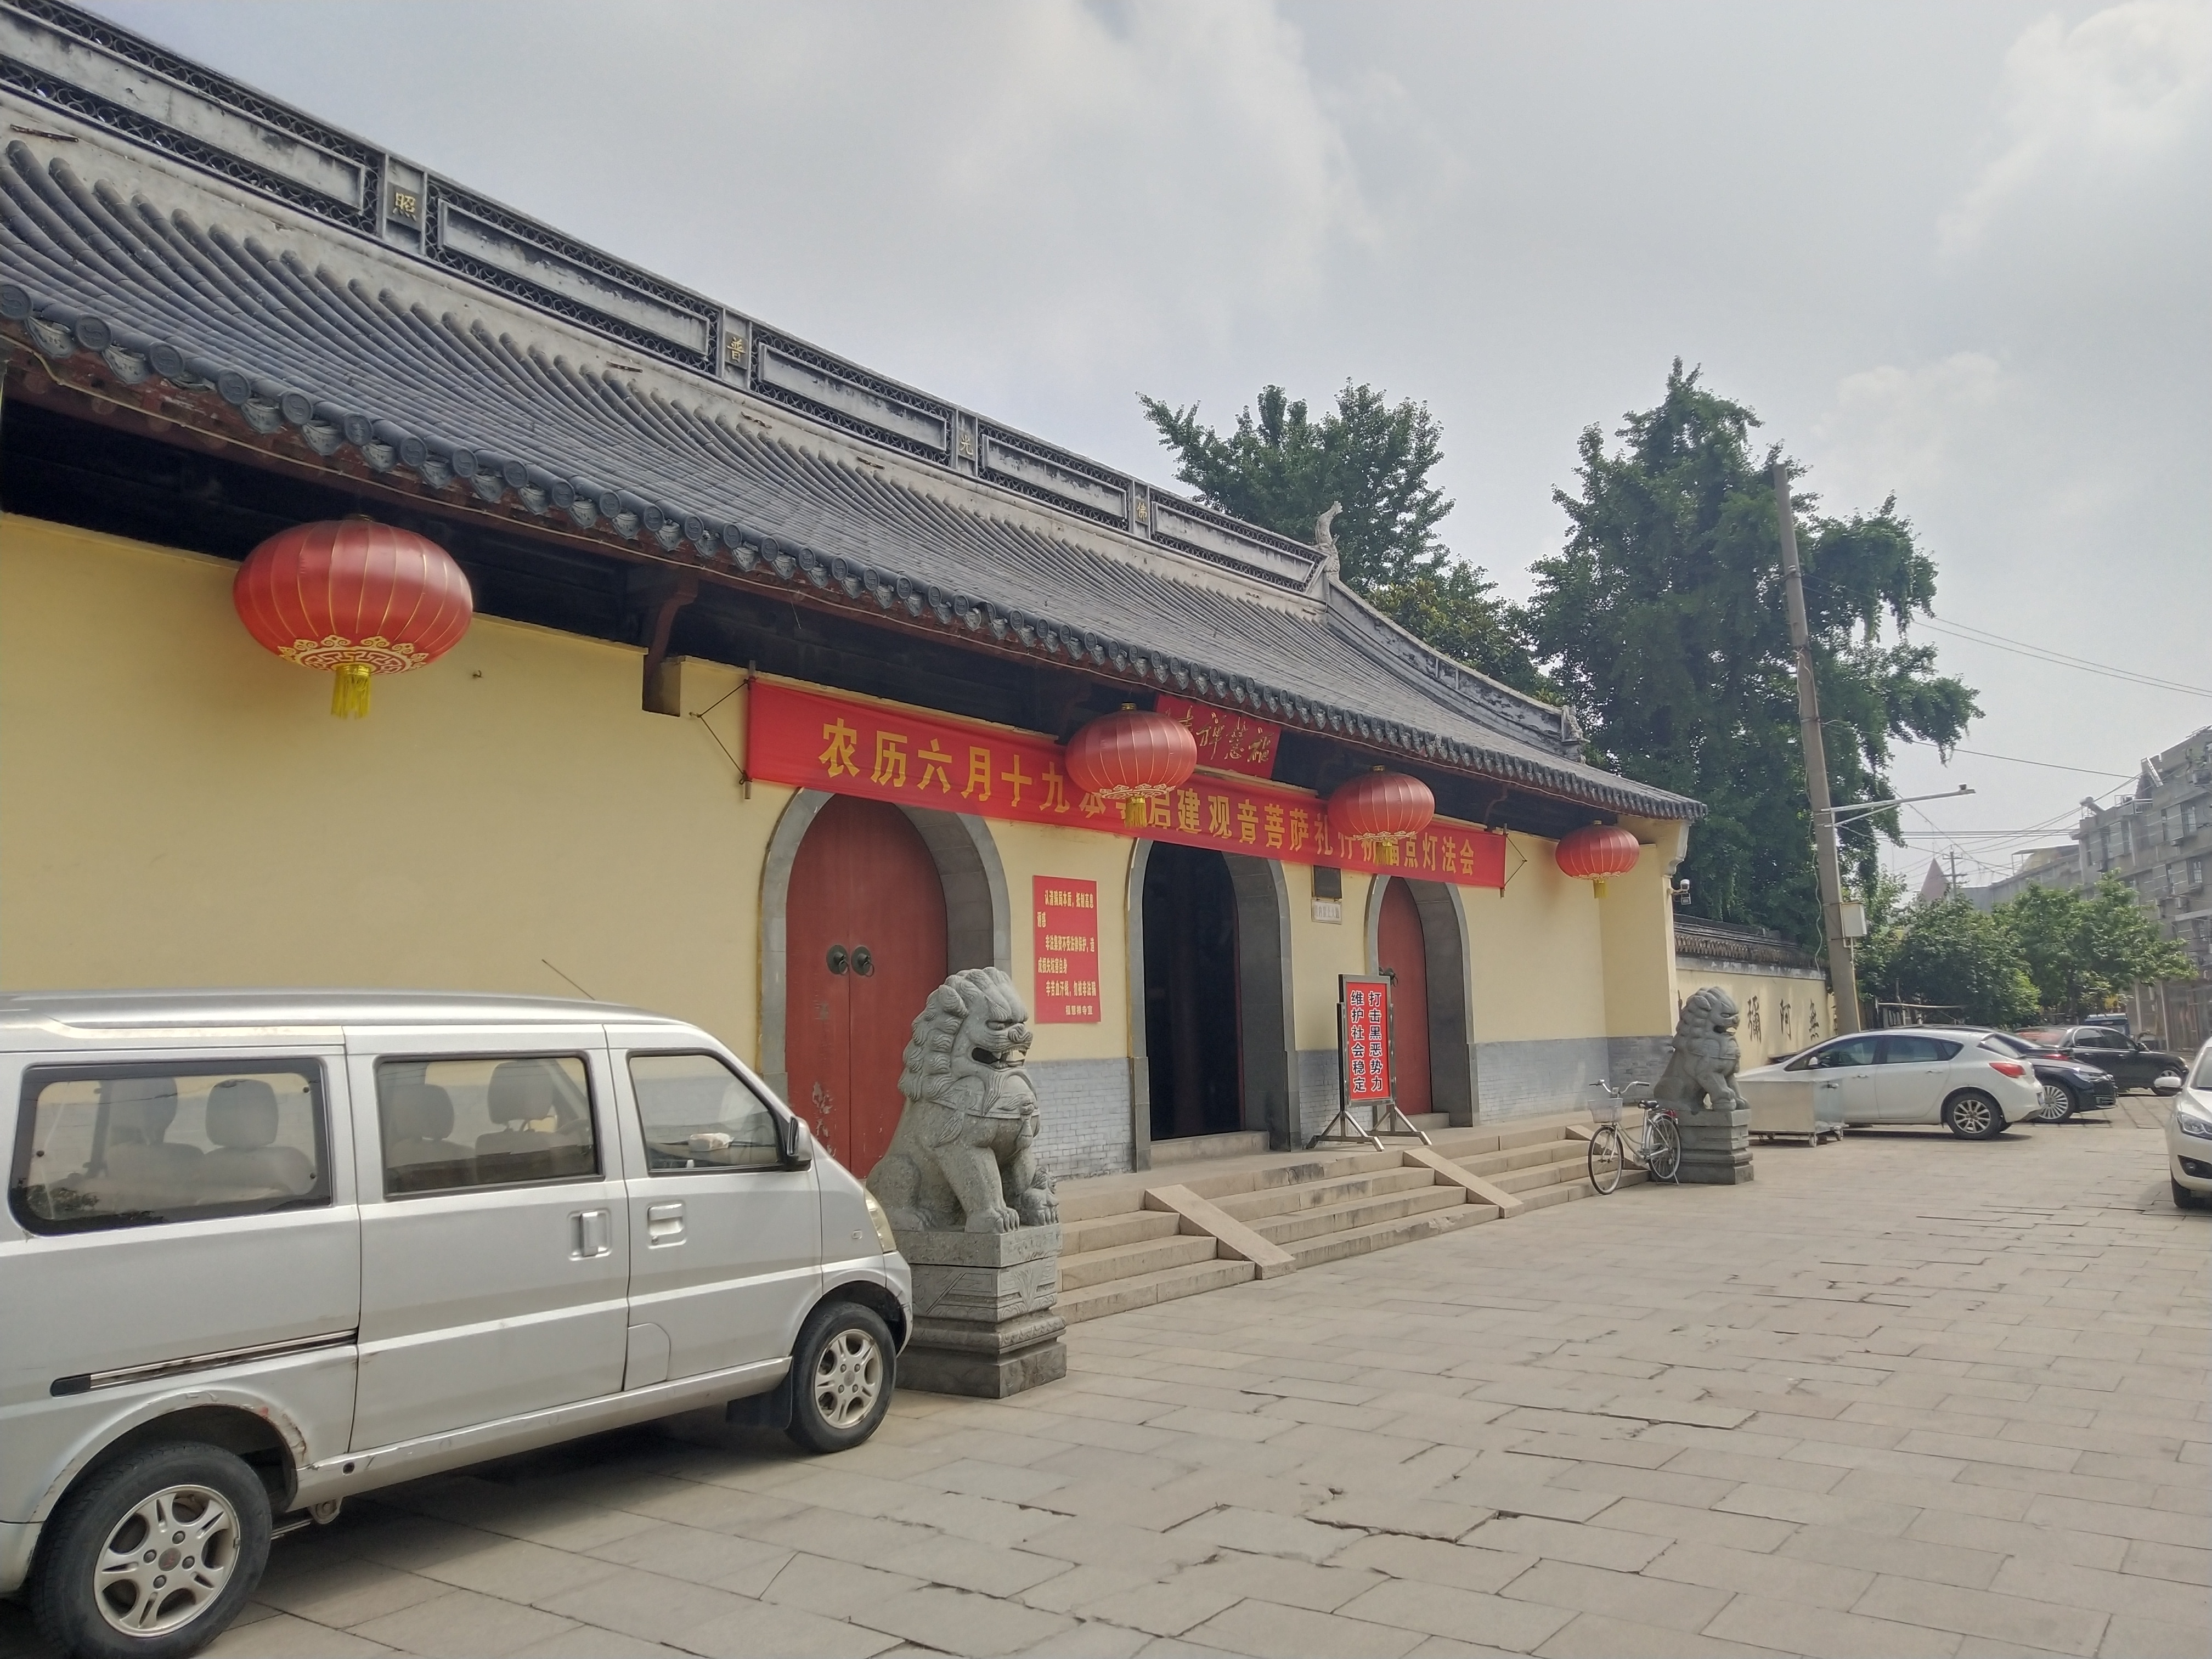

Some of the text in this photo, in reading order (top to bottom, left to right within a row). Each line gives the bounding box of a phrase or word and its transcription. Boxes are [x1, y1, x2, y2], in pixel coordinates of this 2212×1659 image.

[392, 192, 417, 222] 照
[727, 337, 746, 363] 普
[960, 435, 974, 455] 光
[1137, 502, 1147, 521] 佛
[1350, 990, 1367, 1093] 维护社会稳定
[1368, 991, 1383, 1092] 打击黑恶势力
